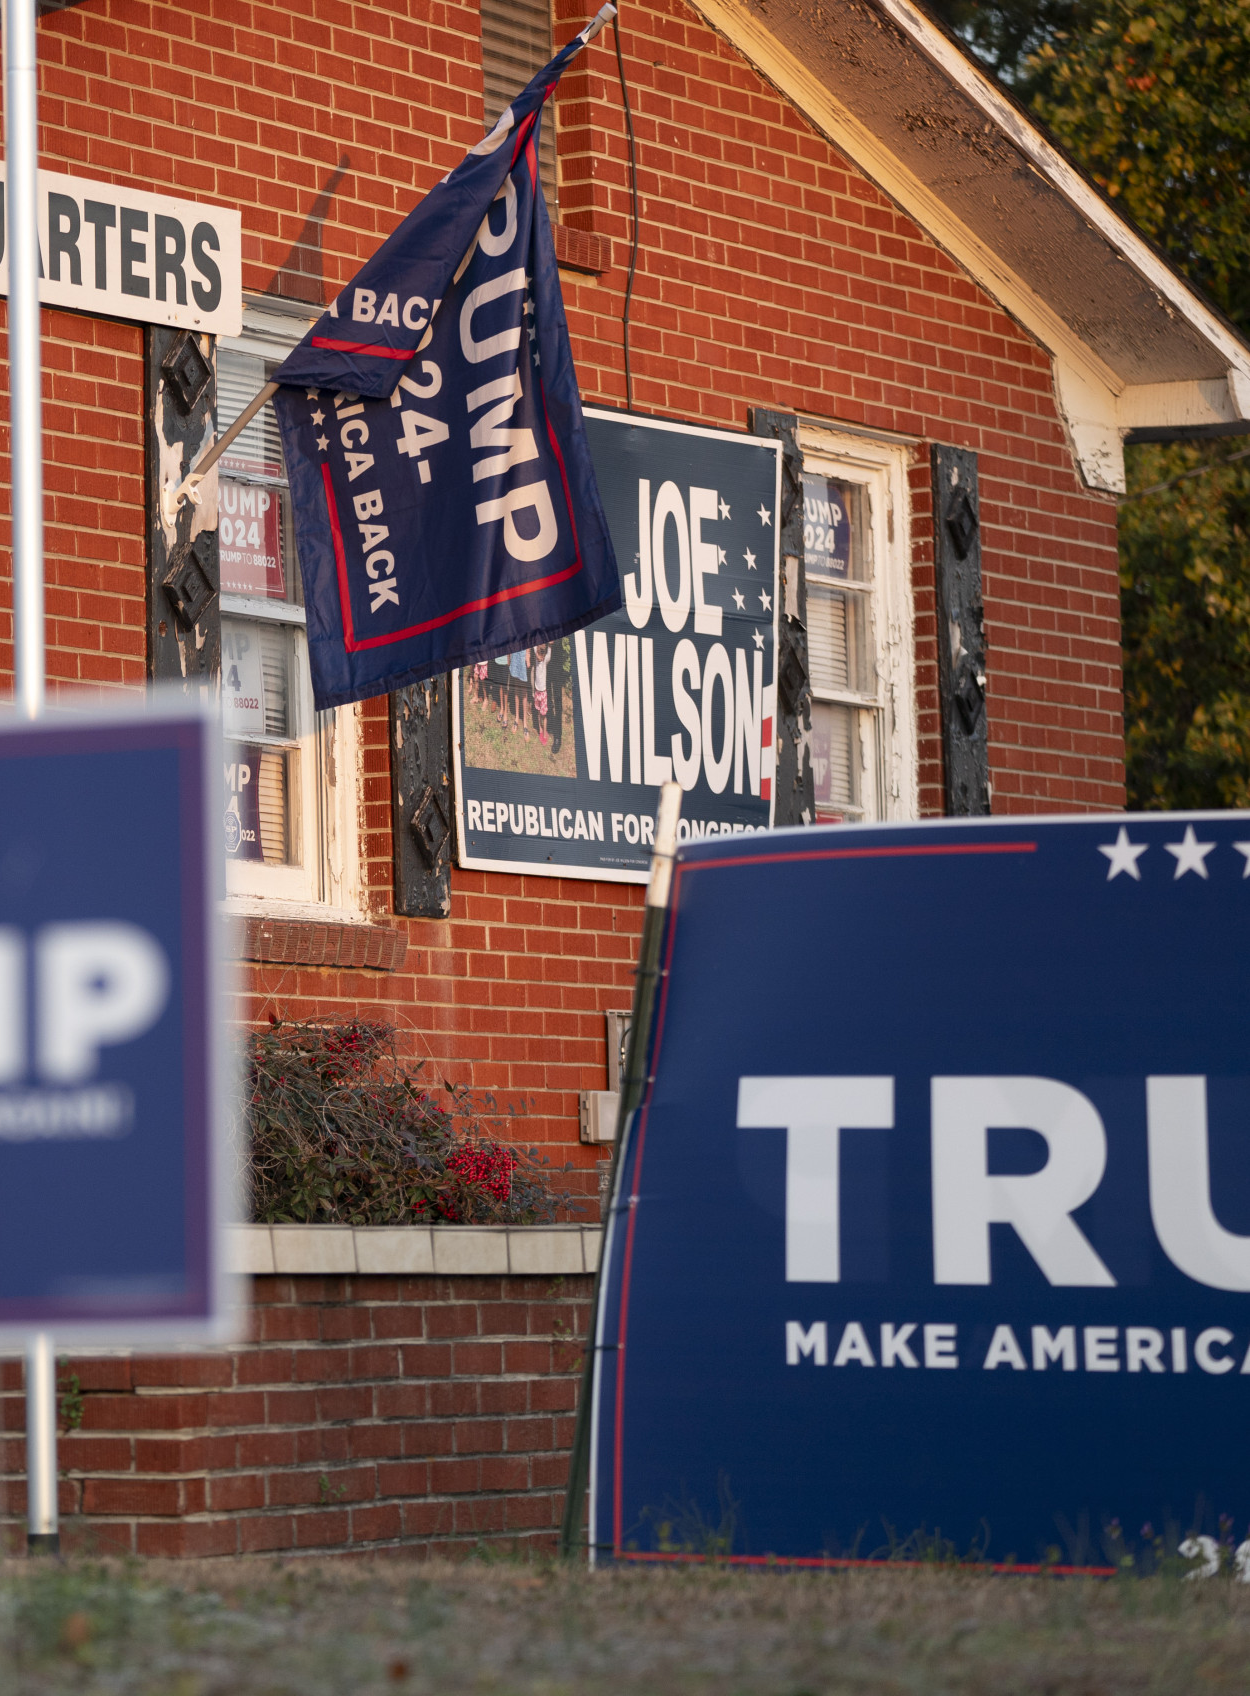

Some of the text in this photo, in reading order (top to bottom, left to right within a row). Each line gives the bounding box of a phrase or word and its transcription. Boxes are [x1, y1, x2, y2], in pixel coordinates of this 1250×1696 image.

[454, 172, 558, 562] RUMP
[219, 485, 270, 518] UMP
[803, 497, 843, 527] UMP
[220, 517, 261, 549] 024
[353, 488, 400, 614] BACK
[805, 524, 836, 554] 024
[220, 550, 242, 563] RUMP
[253, 554, 277, 569] 88022
[624, 478, 723, 637] JOE
[575, 629, 763, 797] WILSON
[241, 829, 256, 842] 022
[467, 799, 605, 842] REPUBLICAN
[611, 812, 655, 845] FOR
[785, 1321, 1250, 1376] MAKE AMERIC
